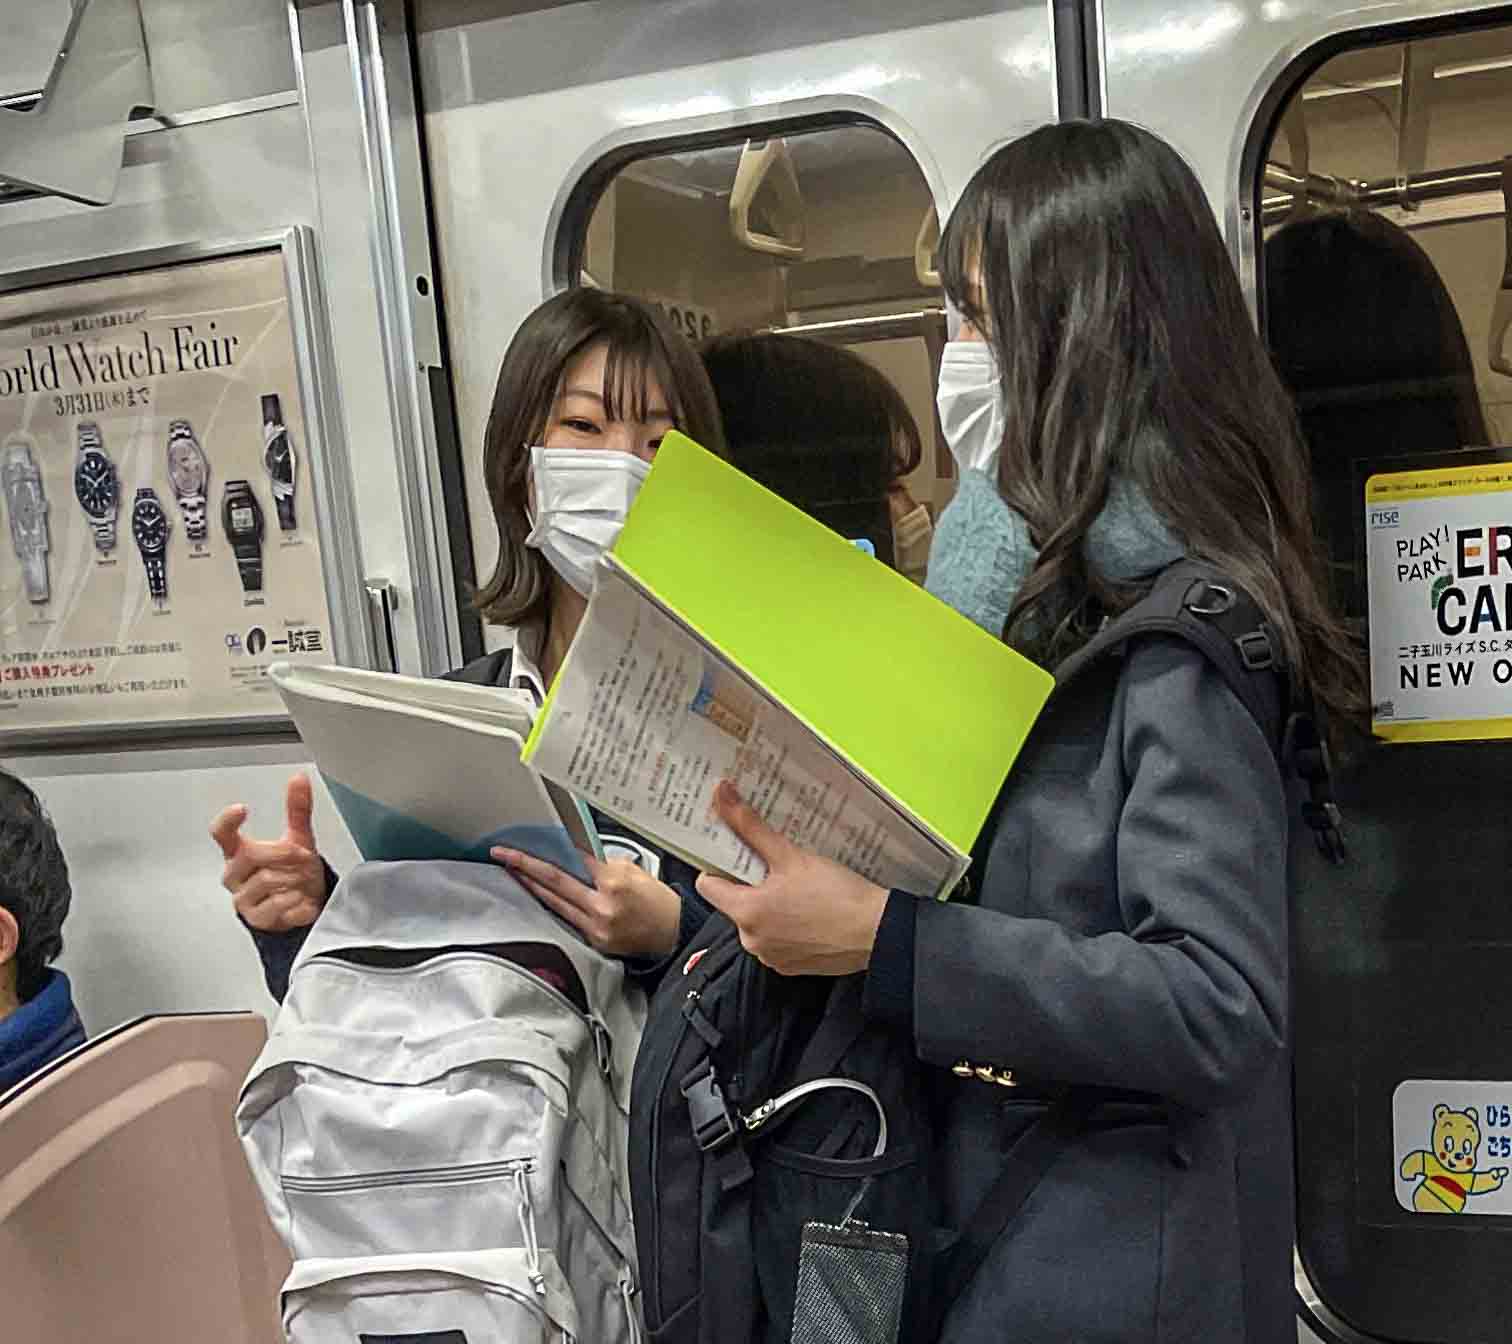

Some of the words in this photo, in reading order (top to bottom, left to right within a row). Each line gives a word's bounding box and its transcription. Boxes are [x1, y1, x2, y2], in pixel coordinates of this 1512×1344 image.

[64, 331, 168, 386] Watch
[170, 322, 239, 373] Fair
[1396, 524, 1450, 558] PLAY!
[1397, 552, 1447, 582] PARK
[1400, 660, 1474, 688] NEW
